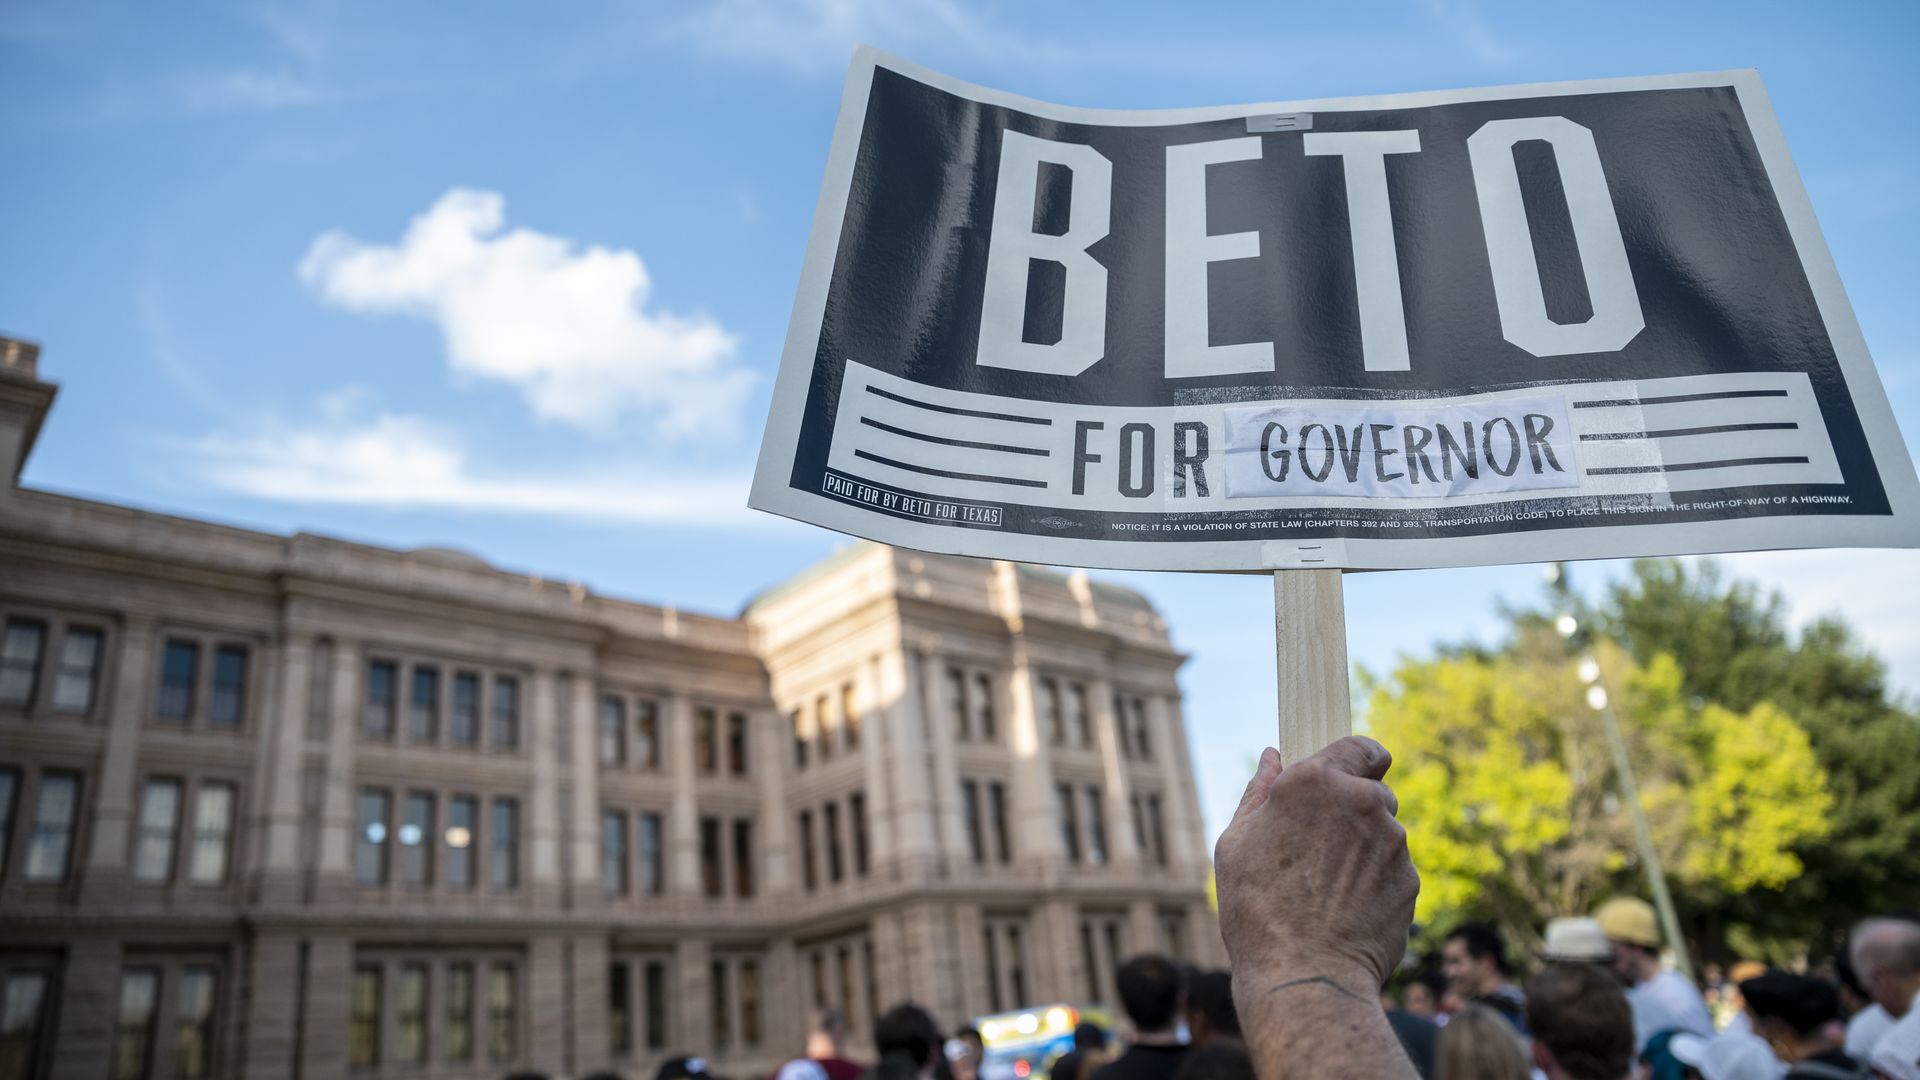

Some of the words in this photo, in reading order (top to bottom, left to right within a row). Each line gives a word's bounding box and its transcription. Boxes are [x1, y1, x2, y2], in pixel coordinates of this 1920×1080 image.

[976, 115, 1646, 379] BETO
[1072, 420, 1209, 499] FOR
[1260, 413, 1565, 486] GOVERNOR
[827, 476, 853, 496] PAID
[857, 486, 879, 504] FOR
[883, 493, 898, 508] BY
[902, 497, 930, 516] BETO
[935, 503, 957, 518] FOR
[963, 507, 998, 523] TEXAS
[1111, 523, 1150, 531] NOTICE:
[1183, 523, 1232, 531] VIOLATION
[1234, 522, 1248, 530] OF
[1250, 521, 1279, 529] STATE
[1281, 520, 1302, 528] LAW
[1304, 520, 1359, 528] (CHAPTERS
[1361, 520, 1377, 528] 392
[1402, 520, 1422, 528] 393,
[1424, 512, 1513, 527] TRANSPORTATION
[1516, 511, 1548, 520] CODE)
[1567, 508, 1600, 516] PLACE
[1604, 506, 1626, 515] THIS
[1629, 505, 1653, 514] SIGN
[1670, 503, 1691, 511] THE
[1693, 497, 1770, 510] RIGHT-OF-WAY
[1773, 496, 1788, 504] OF
[1800, 496, 1853, 504] HIGHWAY.
